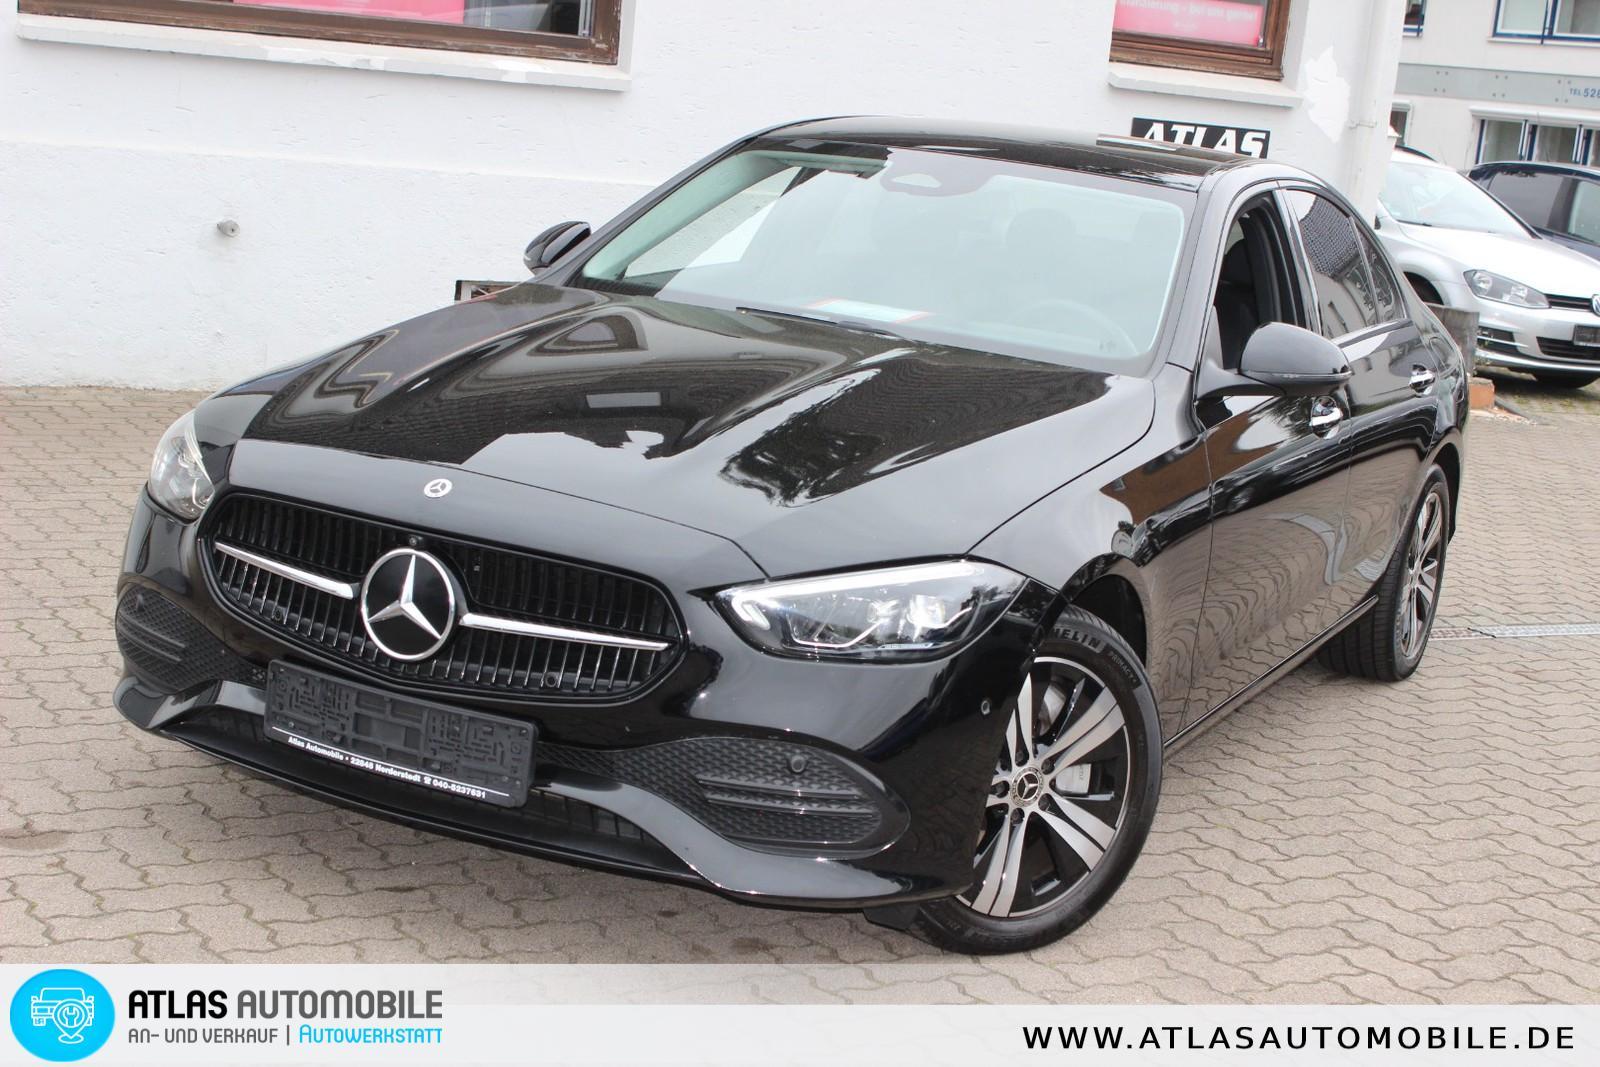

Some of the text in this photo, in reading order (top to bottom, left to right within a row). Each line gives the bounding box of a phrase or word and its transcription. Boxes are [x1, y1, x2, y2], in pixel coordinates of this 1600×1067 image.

[1143, 122, 1267, 159] ATLAS
[1053, 627, 1101, 650] HELIN
[287, 736, 305, 748] Atlas
[305, 742, 344, 761] Automobile
[375, 763, 421, 783] Norderstedt
